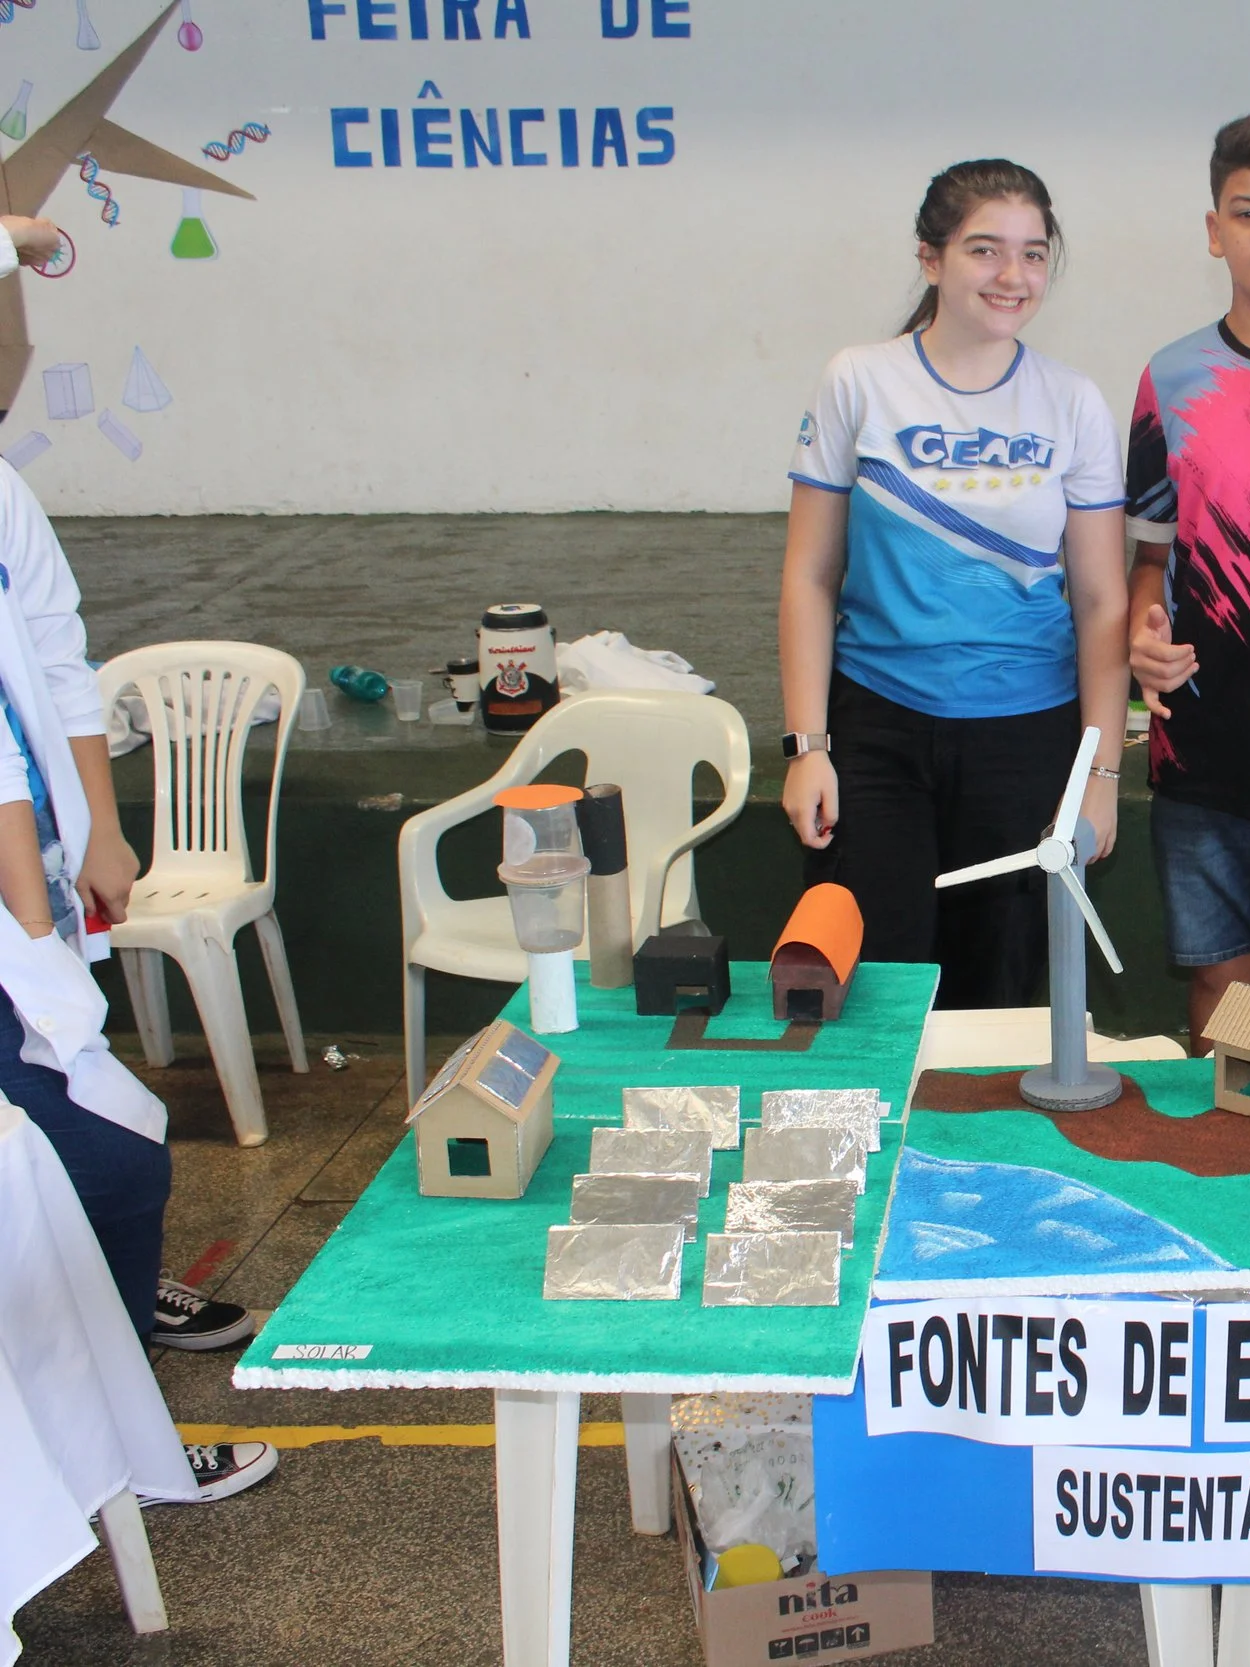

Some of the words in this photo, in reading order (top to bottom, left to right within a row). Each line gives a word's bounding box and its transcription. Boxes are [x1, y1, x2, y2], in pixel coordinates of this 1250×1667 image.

[308, 0, 531, 41] FEIRA
[602, 0, 692, 39] DE
[330, 80, 676, 168] CIÊNCIAS
[899, 425, 1056, 470] CEART
[888, 1312, 1089, 1417] FONTES
[1123, 1320, 1189, 1417] DE
